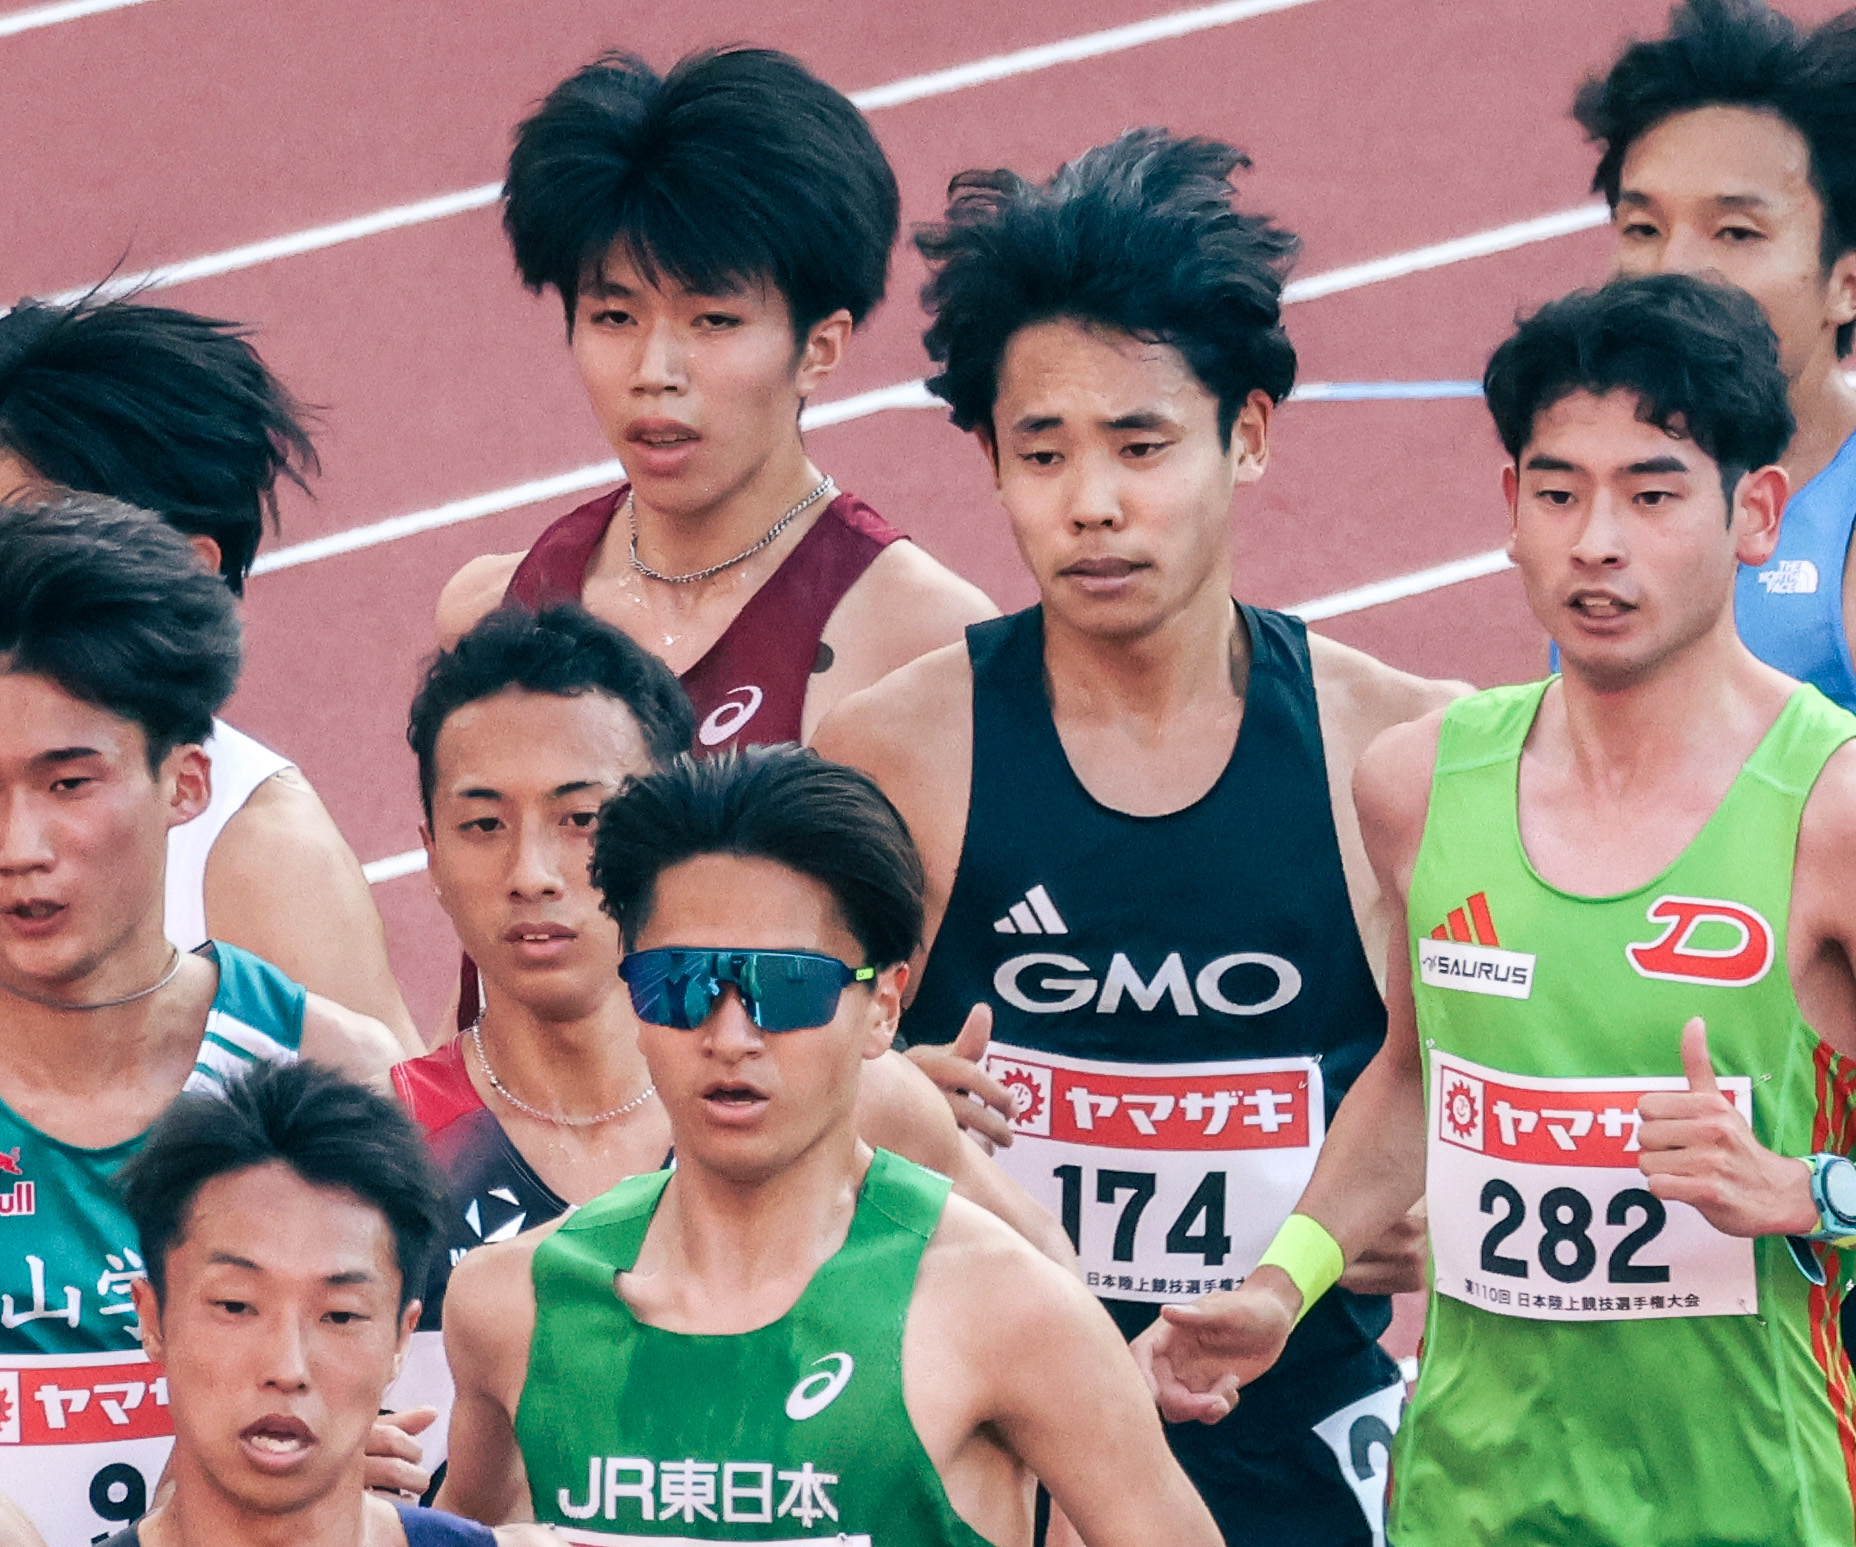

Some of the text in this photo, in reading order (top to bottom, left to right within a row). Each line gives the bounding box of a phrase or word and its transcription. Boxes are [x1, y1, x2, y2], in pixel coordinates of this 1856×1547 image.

[993, 951, 1302, 1017] GMO
[1437, 956, 1528, 986] SAURUS
[1065, 1086, 1293, 1135] ヤマザキ
[1053, 1164, 1232, 1266] 174
[1480, 1178, 1671, 1284] 282
[1517, 1293, 1700, 1312] 日本陸上競技選手権大会
[557, 1456, 840, 1528] JR東日本
